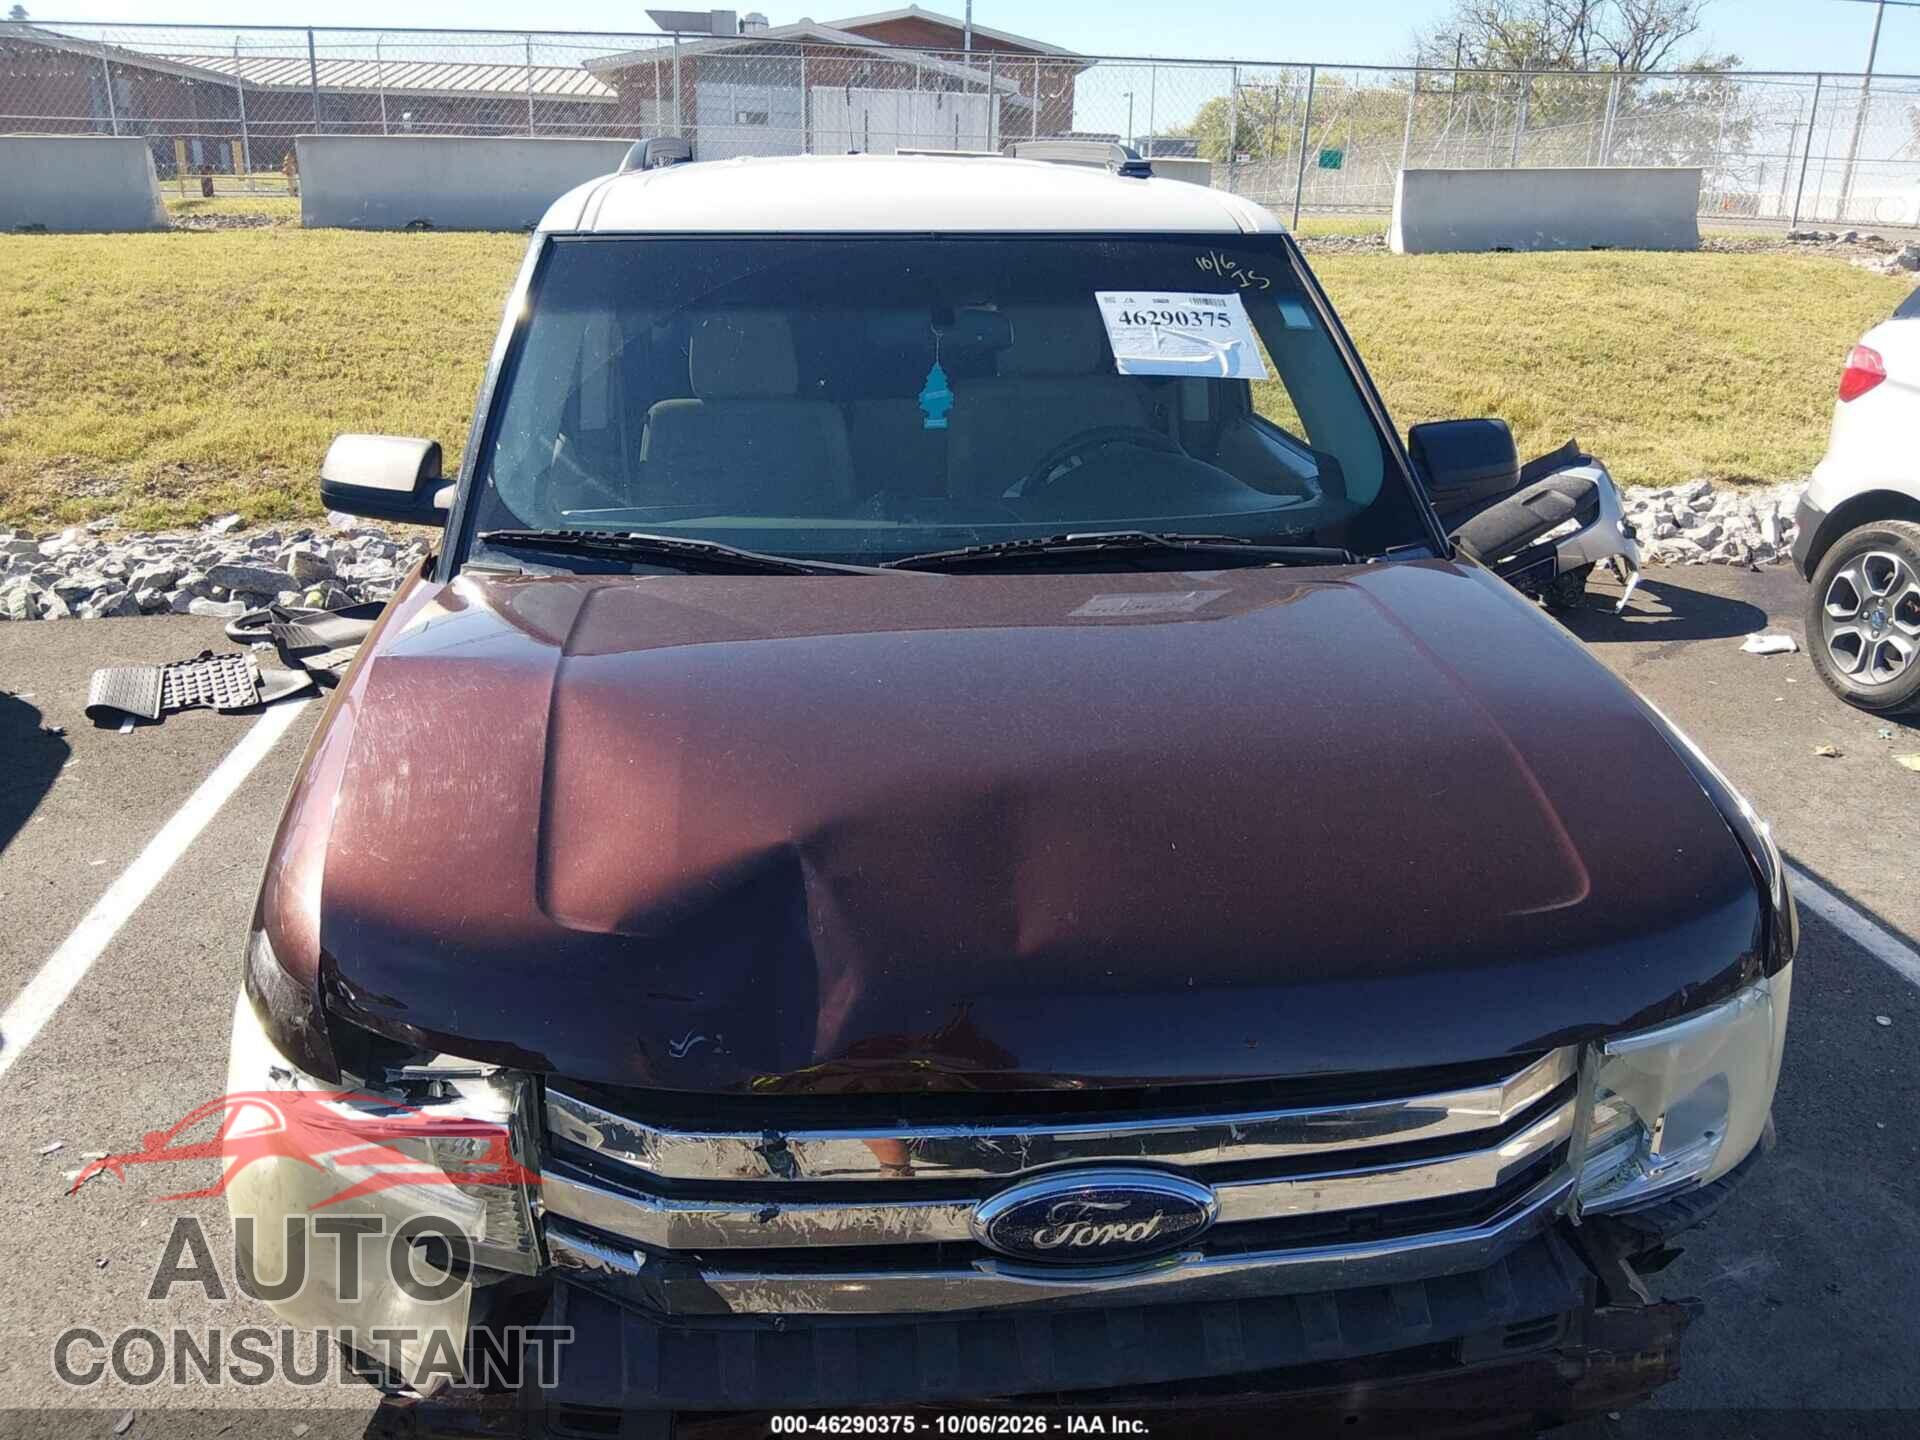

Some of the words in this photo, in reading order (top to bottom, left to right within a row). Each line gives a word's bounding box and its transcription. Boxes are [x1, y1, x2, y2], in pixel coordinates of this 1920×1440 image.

[1195, 250, 1236, 276] 10/6
[1118, 309, 1232, 328] 46290375
[1033, 1199, 1163, 1248] Ford
